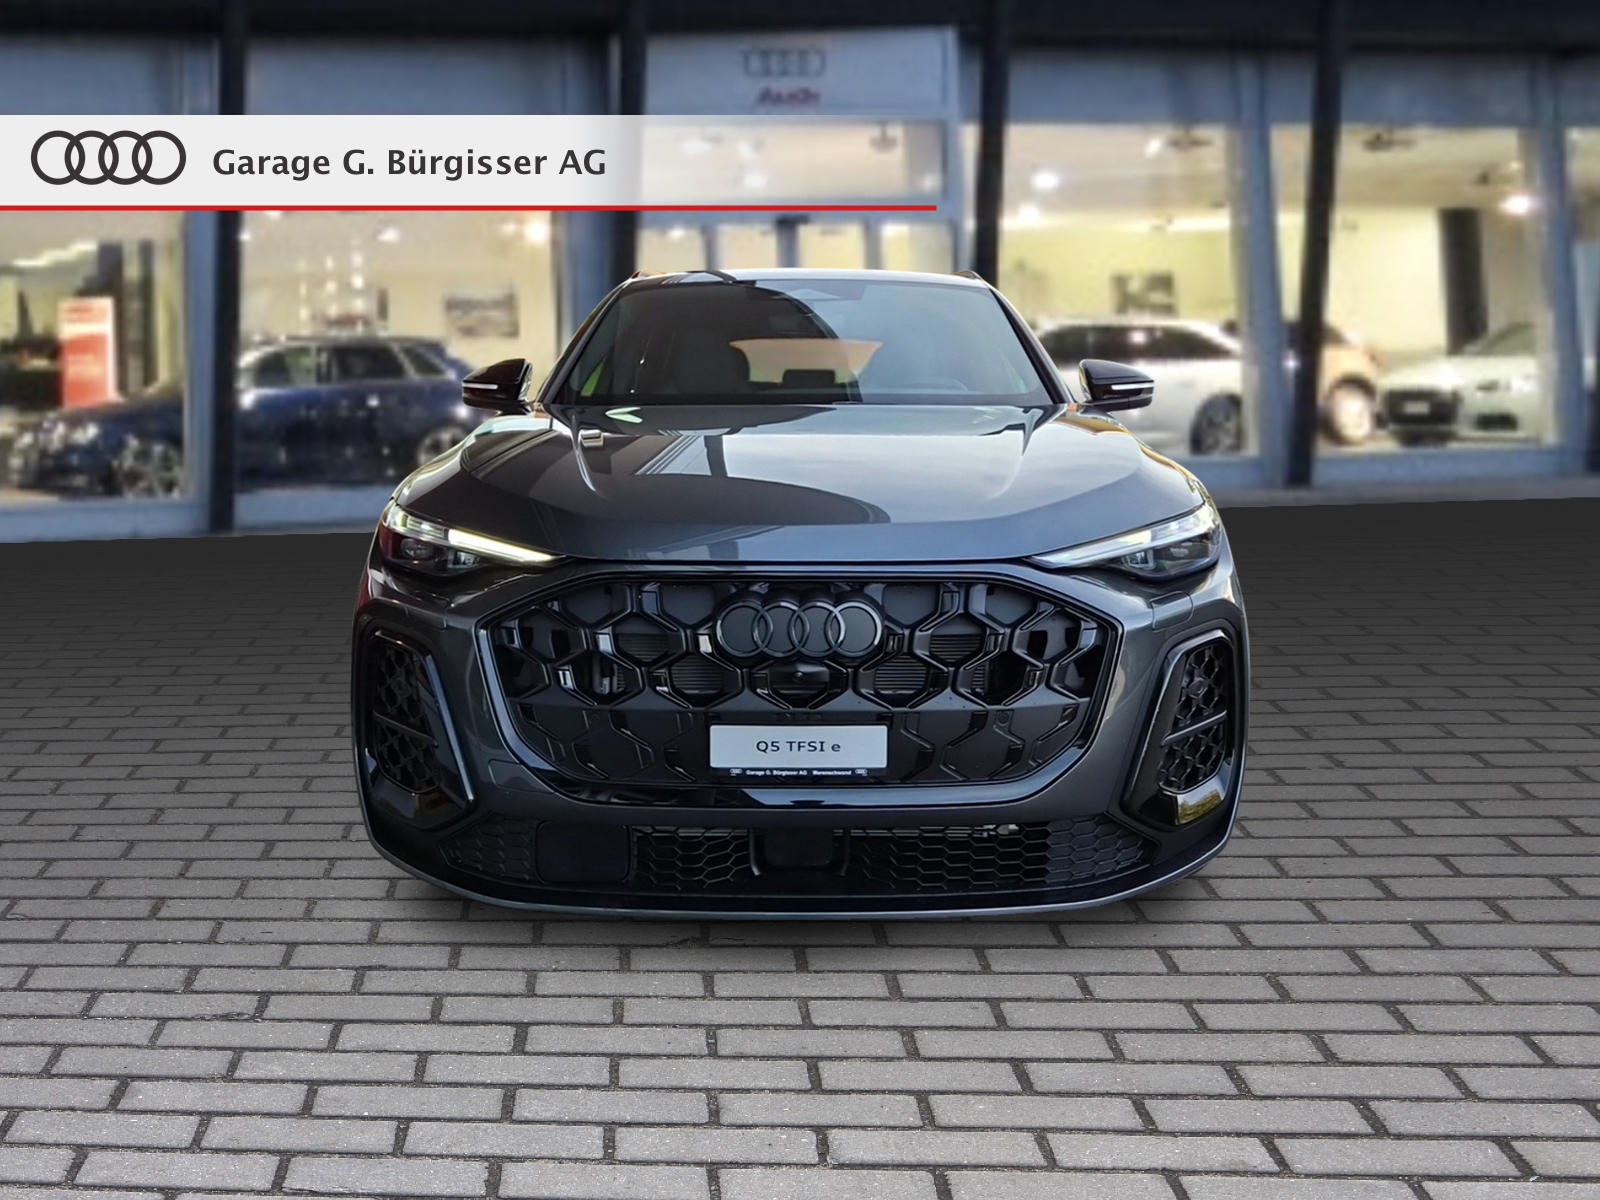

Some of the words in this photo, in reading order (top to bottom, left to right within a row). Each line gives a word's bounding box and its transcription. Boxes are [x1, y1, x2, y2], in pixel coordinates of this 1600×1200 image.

[755, 740, 781, 755] Q5
[785, 740, 826, 753] TFSI
[831, 743, 841, 753] e
[745, 769, 765, 777] Garage
